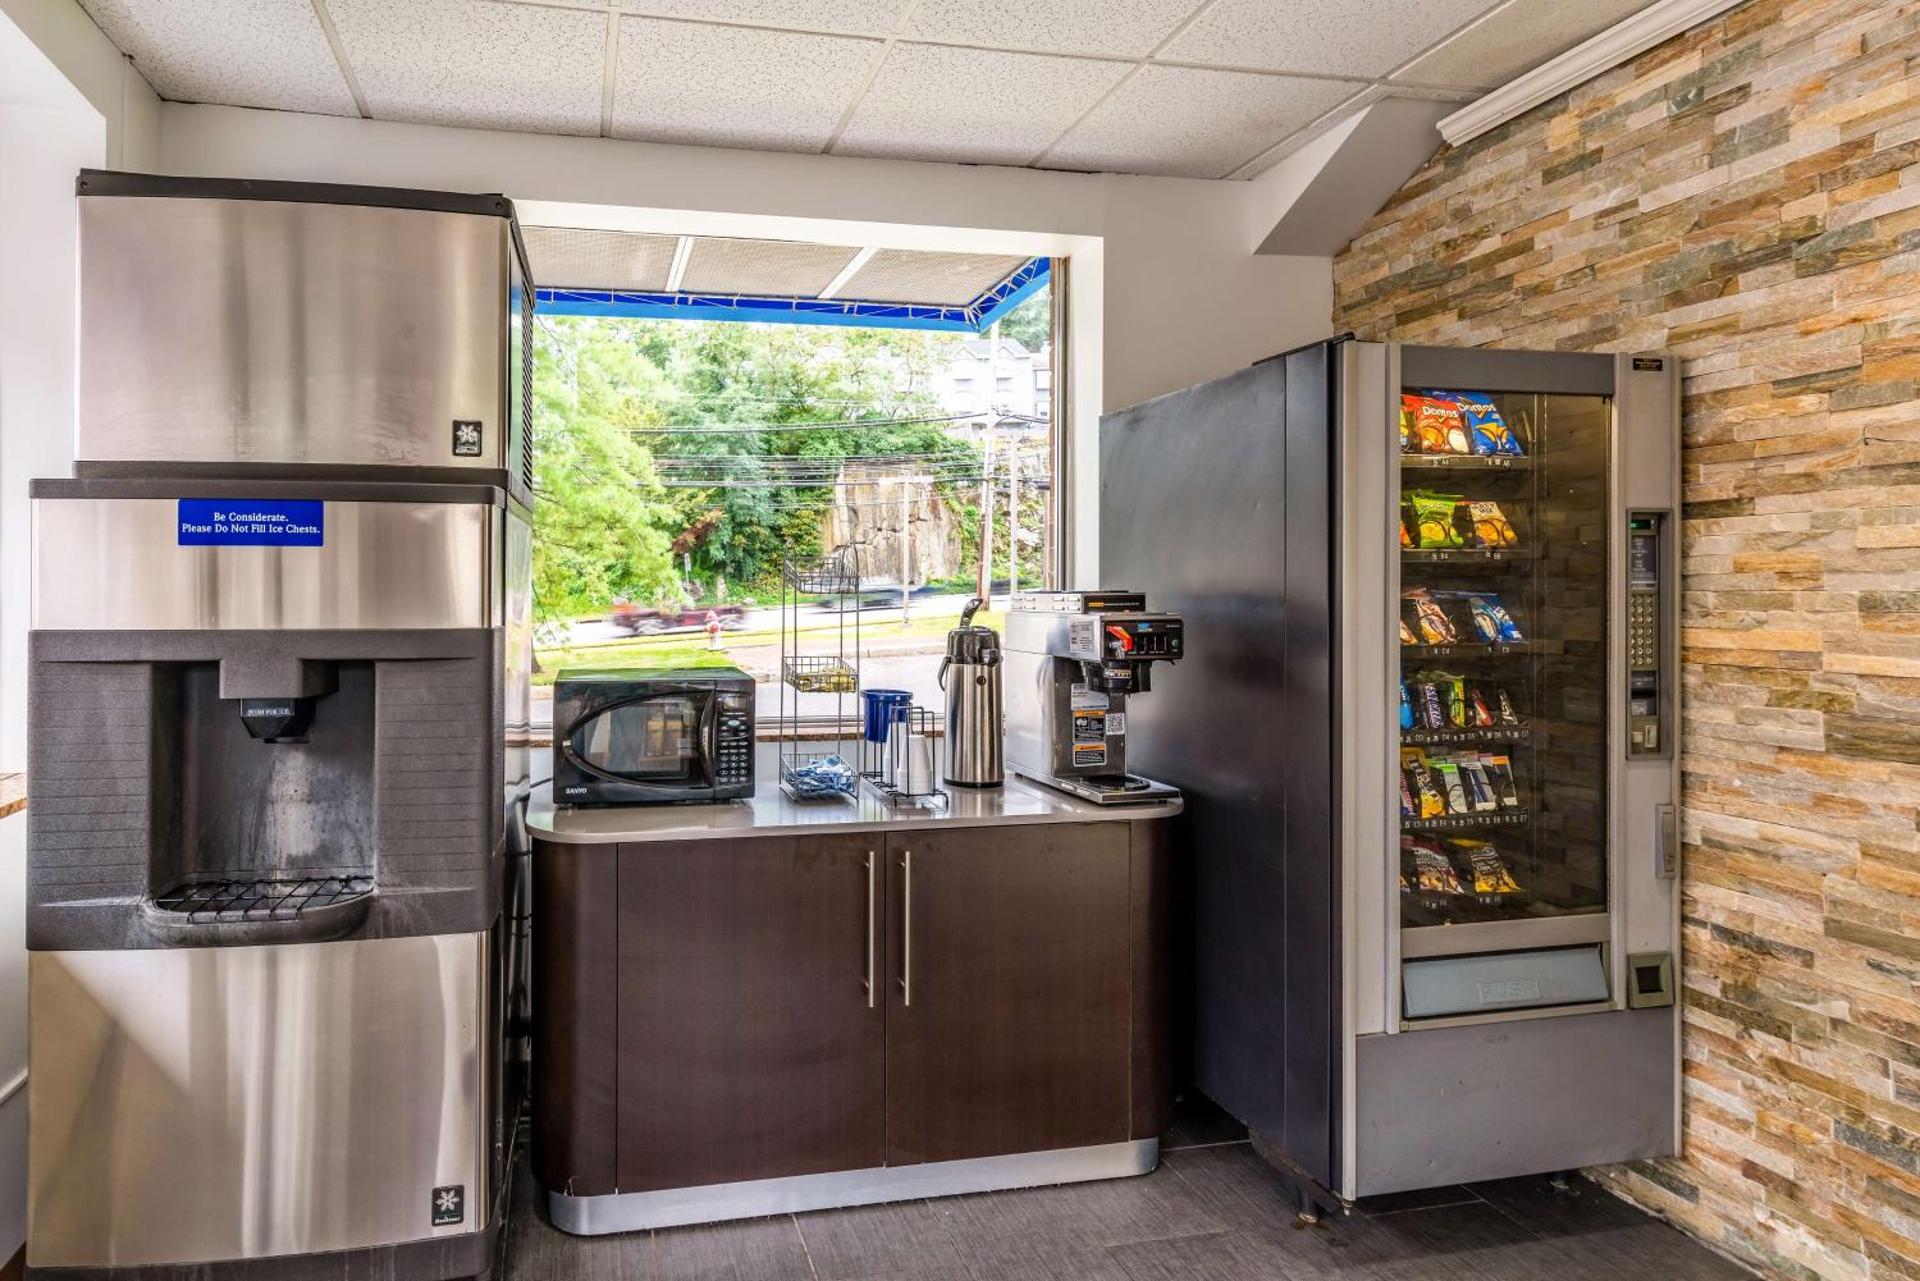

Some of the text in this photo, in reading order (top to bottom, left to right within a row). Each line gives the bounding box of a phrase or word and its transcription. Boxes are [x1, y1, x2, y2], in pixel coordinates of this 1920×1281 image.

[213, 512, 289, 522] Be Considerate.
[182, 523, 321, 534] Please Do Not Fill Ice Chests.
